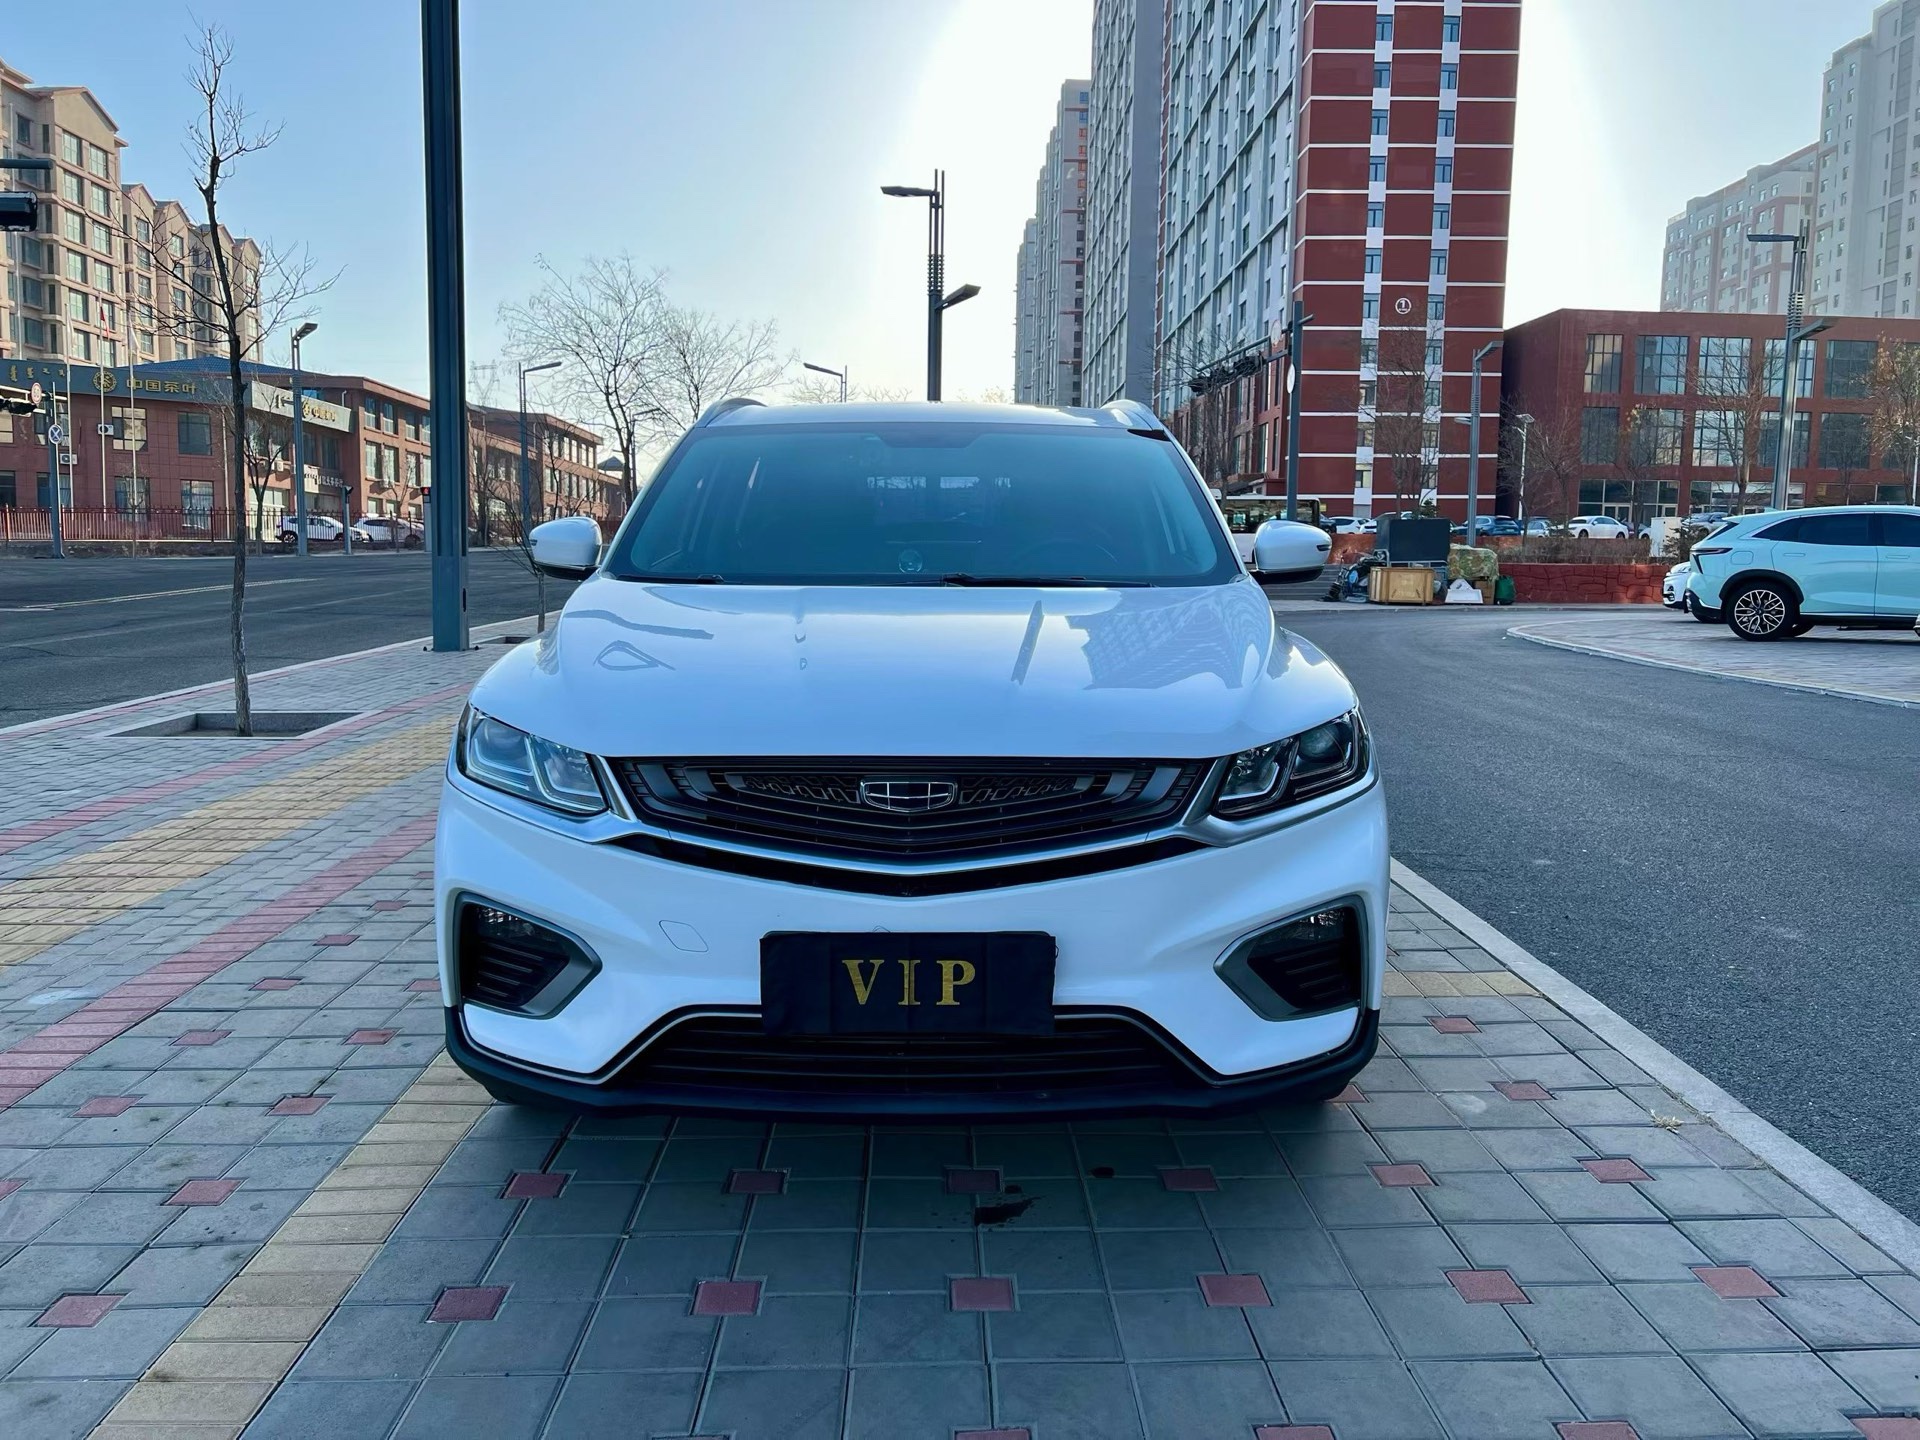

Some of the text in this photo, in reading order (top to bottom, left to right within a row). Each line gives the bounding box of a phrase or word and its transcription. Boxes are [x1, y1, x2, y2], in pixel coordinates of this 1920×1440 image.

[126, 377, 197, 395] 中国茶叶
[842, 959, 976, 1006] VIP
